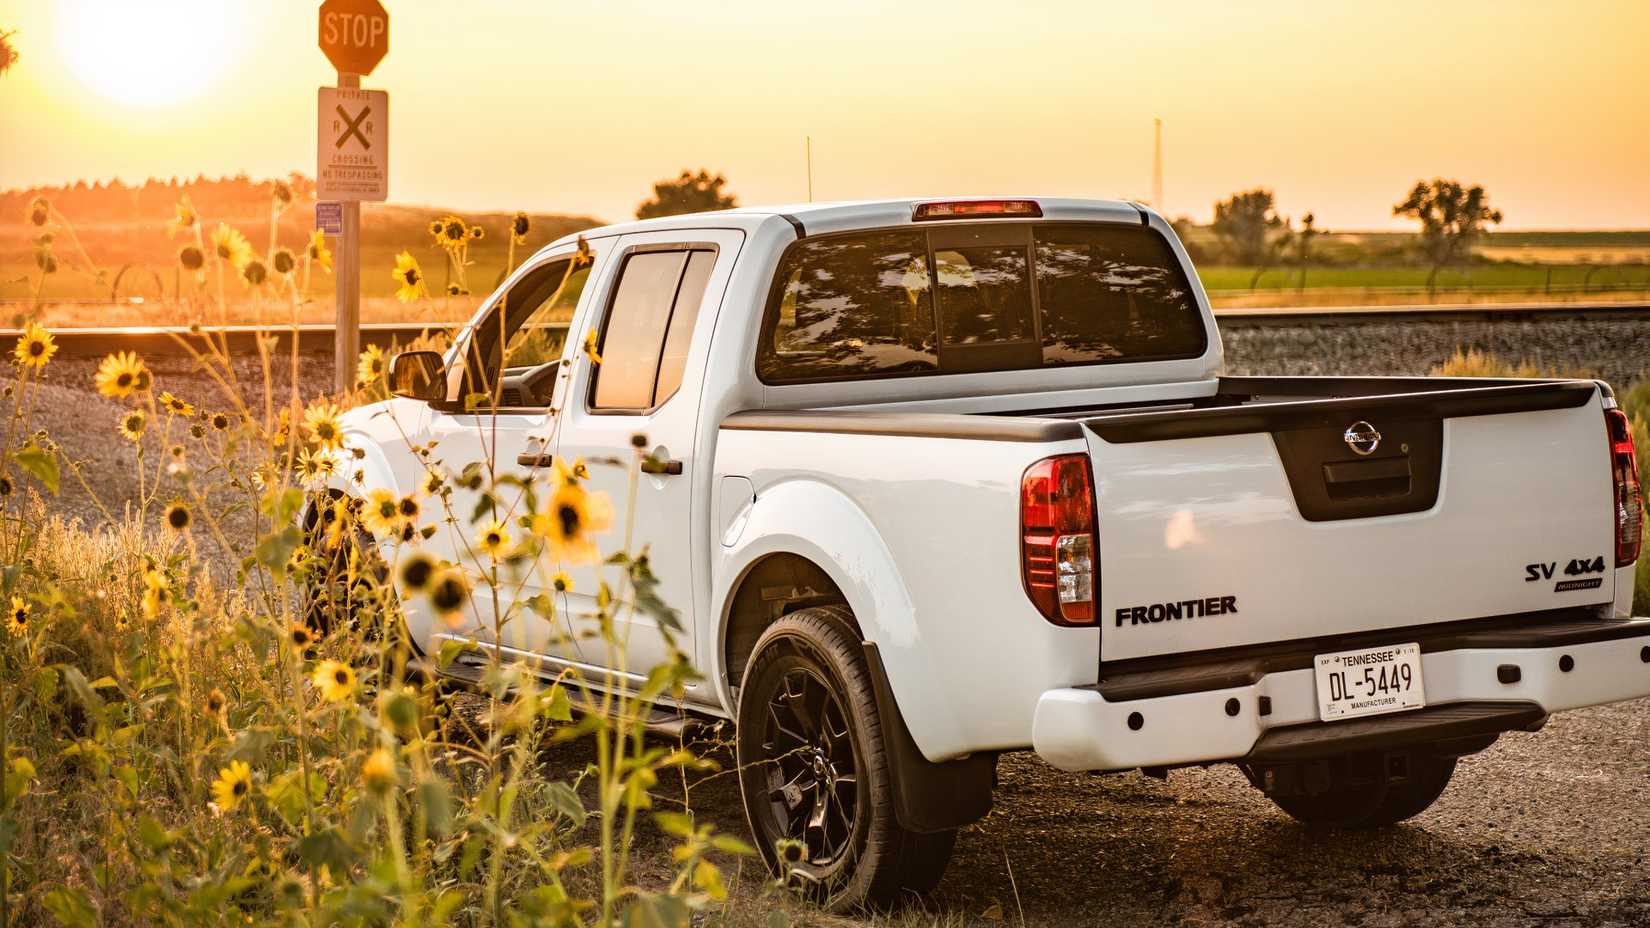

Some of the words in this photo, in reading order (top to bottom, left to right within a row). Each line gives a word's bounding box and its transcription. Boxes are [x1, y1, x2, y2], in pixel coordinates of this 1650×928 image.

[324, 12, 384, 48] STOP
[366, 121, 373, 136] R
[1525, 562, 1556, 582] SV
[1115, 595, 1238, 627] FRONTIER
[1342, 651, 1394, 667] TENNESSEE
[1329, 663, 1412, 701] DL-5449
[1351, 697, 1397, 709] MANUFACTURER
